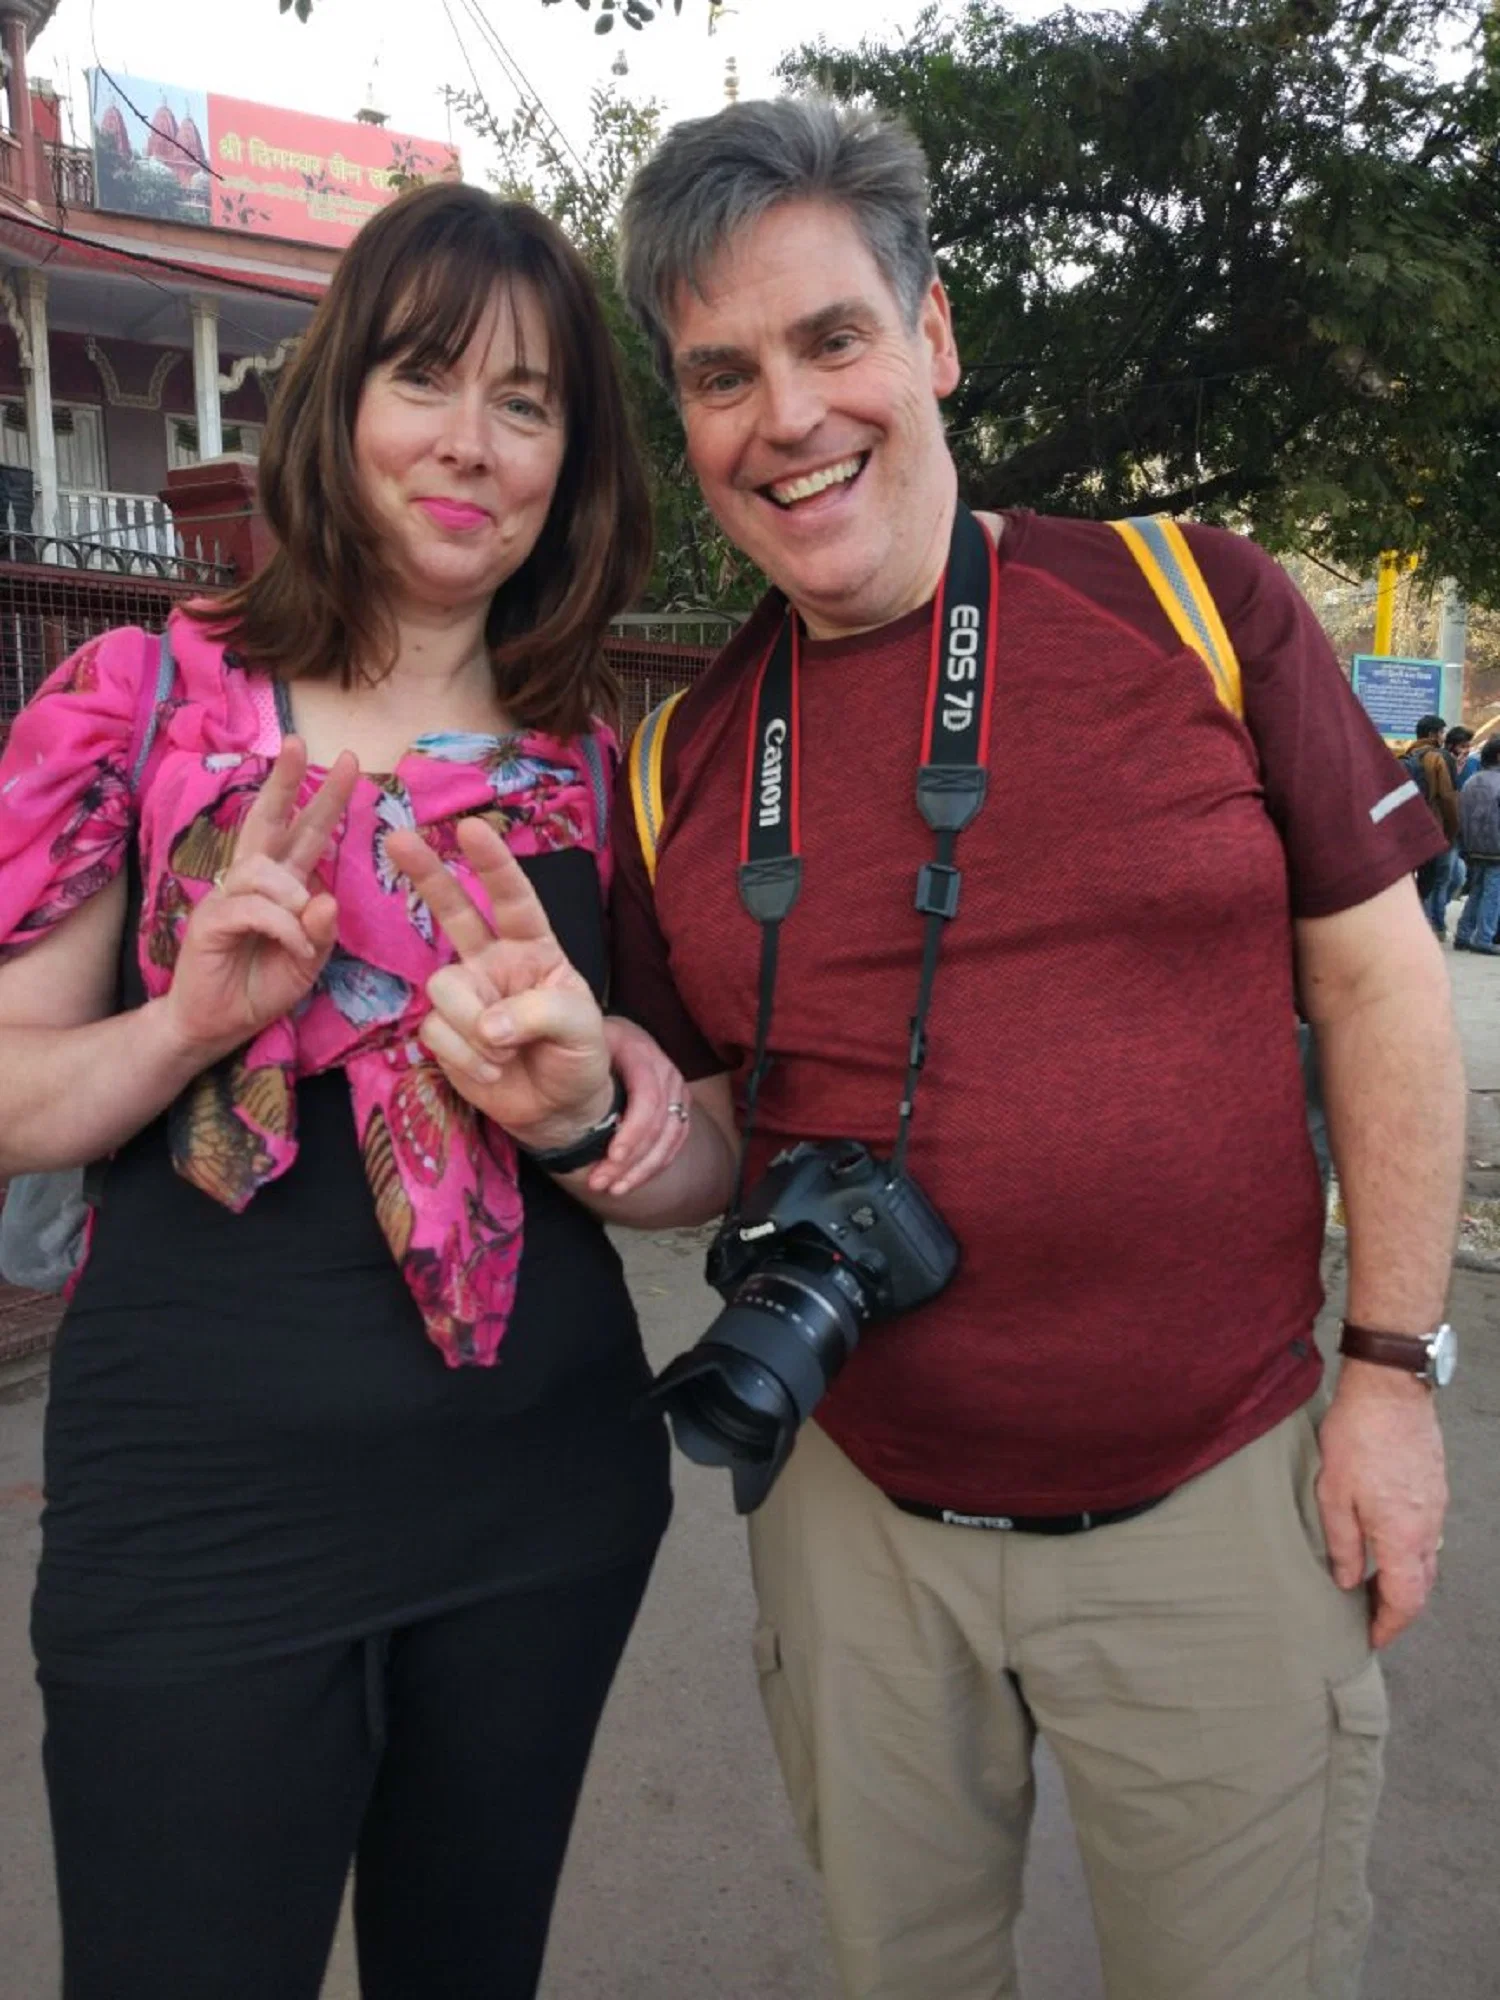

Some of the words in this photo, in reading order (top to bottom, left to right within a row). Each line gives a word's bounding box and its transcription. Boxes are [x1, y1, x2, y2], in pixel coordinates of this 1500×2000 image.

[947, 604, 979, 682] EOS
[943, 690, 975, 732] 7D
[759, 718, 787, 827] Canon
